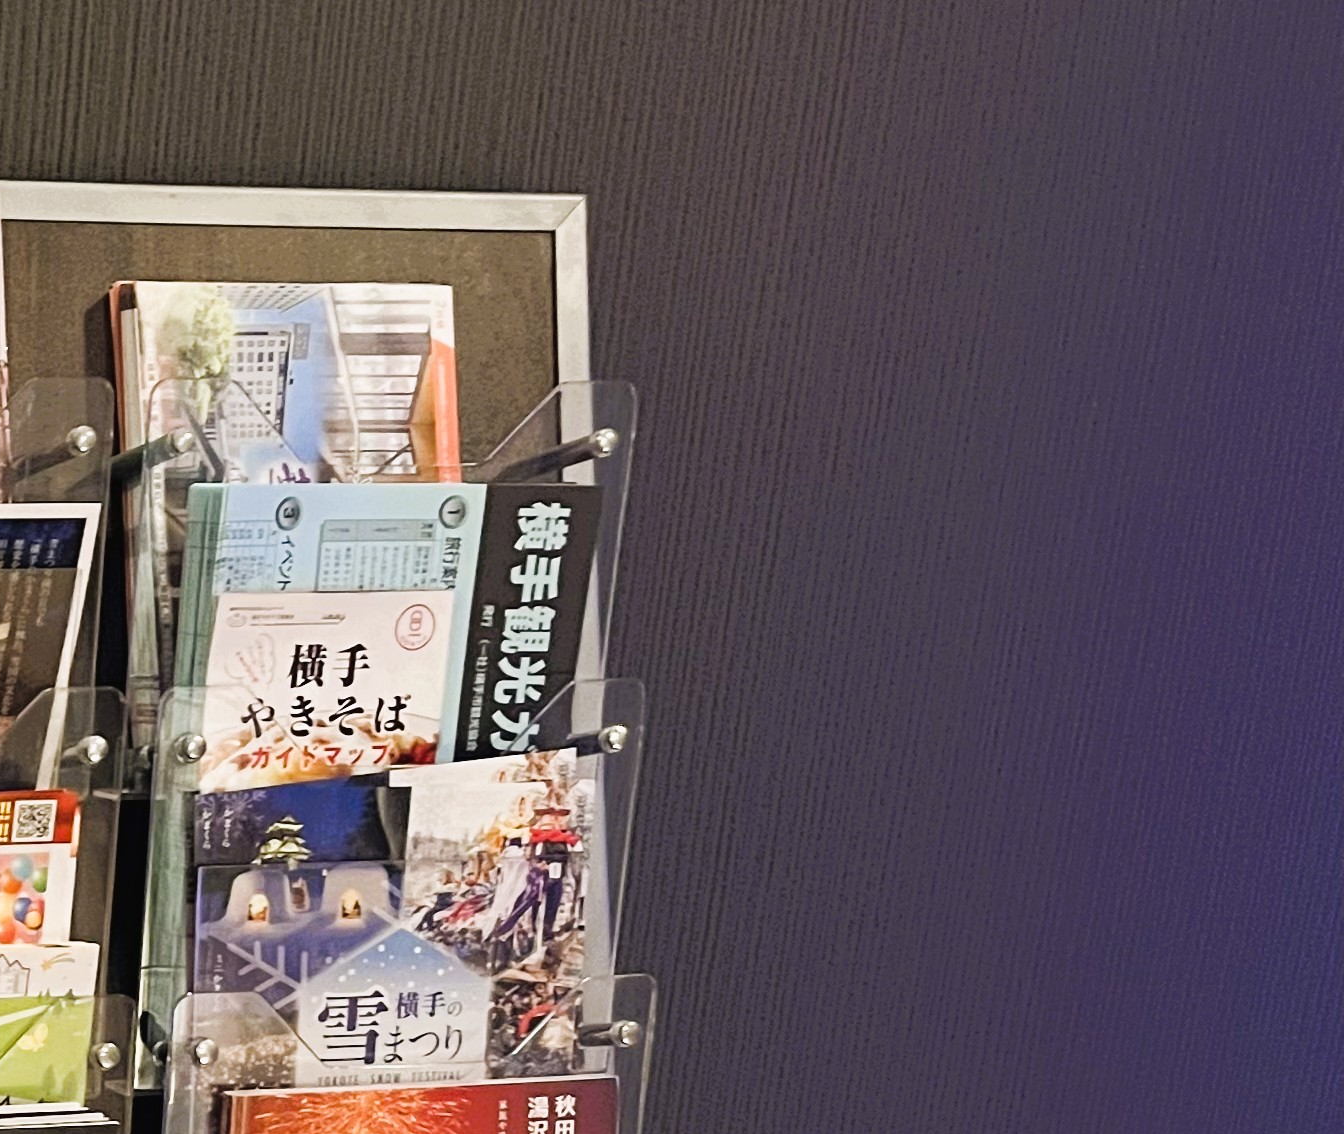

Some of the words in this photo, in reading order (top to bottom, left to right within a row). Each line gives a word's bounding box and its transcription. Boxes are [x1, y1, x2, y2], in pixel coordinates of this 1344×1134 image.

[287, 643, 371, 689] 横手
[241, 692, 412, 740] やきそば
[250, 743, 392, 770] ガイドマップ
[396, 991, 464, 1019] 横手の
[317, 989, 389, 1065] 雪
[384, 1025, 464, 1064] まつり
